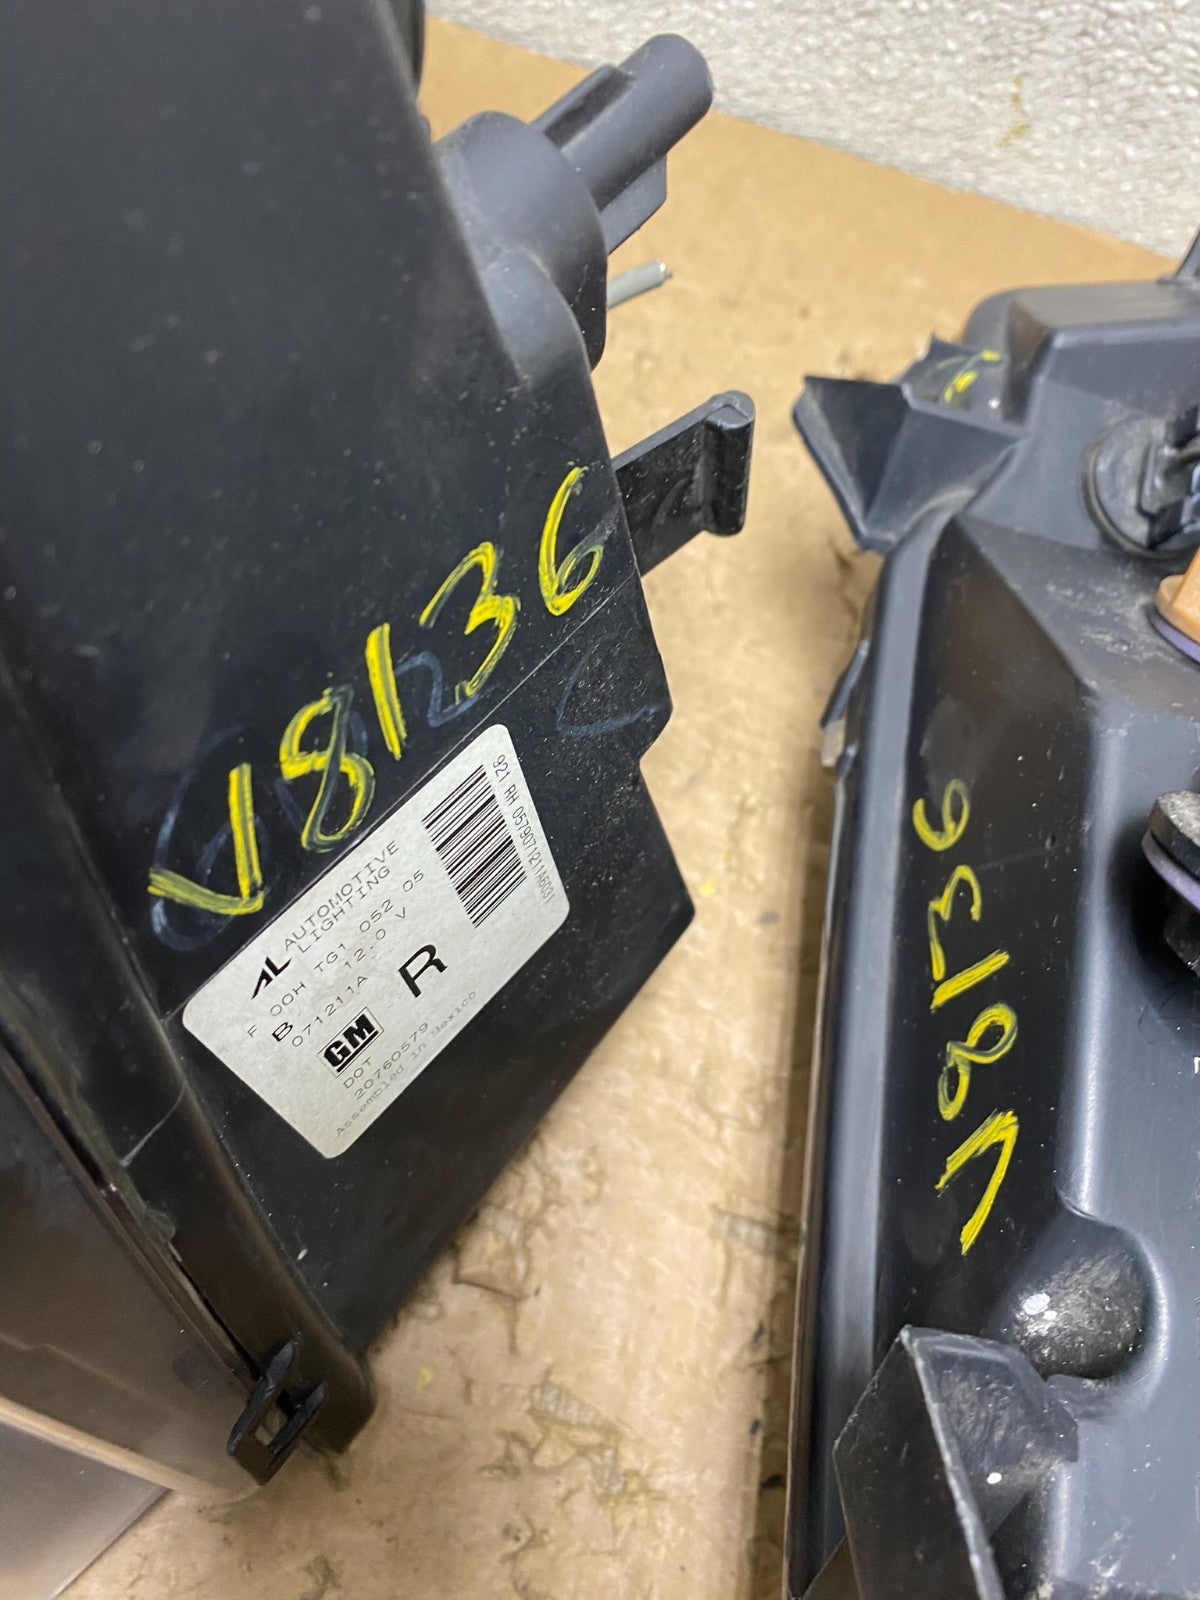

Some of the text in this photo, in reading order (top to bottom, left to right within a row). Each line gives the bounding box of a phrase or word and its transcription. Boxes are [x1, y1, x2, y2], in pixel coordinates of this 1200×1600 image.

[148, 464, 604, 915] V8136
[492, 754, 511, 783] 921
[503, 784, 520, 806] RH
[284, 840, 400, 951] AUTOMOTIVE
[297, 866, 391, 954] LIGHTING
[246, 1024, 258, 1038] F
[313, 943, 347, 973] TG1
[359, 899, 393, 933] 052
[402, 869, 425, 893] 05
[344, 906, 407, 970] 12.0 V
[398, 944, 448, 998] R
[271, 1021, 294, 1042] B
[291, 976, 368, 1047] 071211A
[323, 1013, 376, 1067] GM
[336, 1065, 405, 1137] Assembled
[411, 1043, 427, 1060] in
[343, 1057, 372, 1089] DOT
[354, 1022, 429, 1100] 20760579
